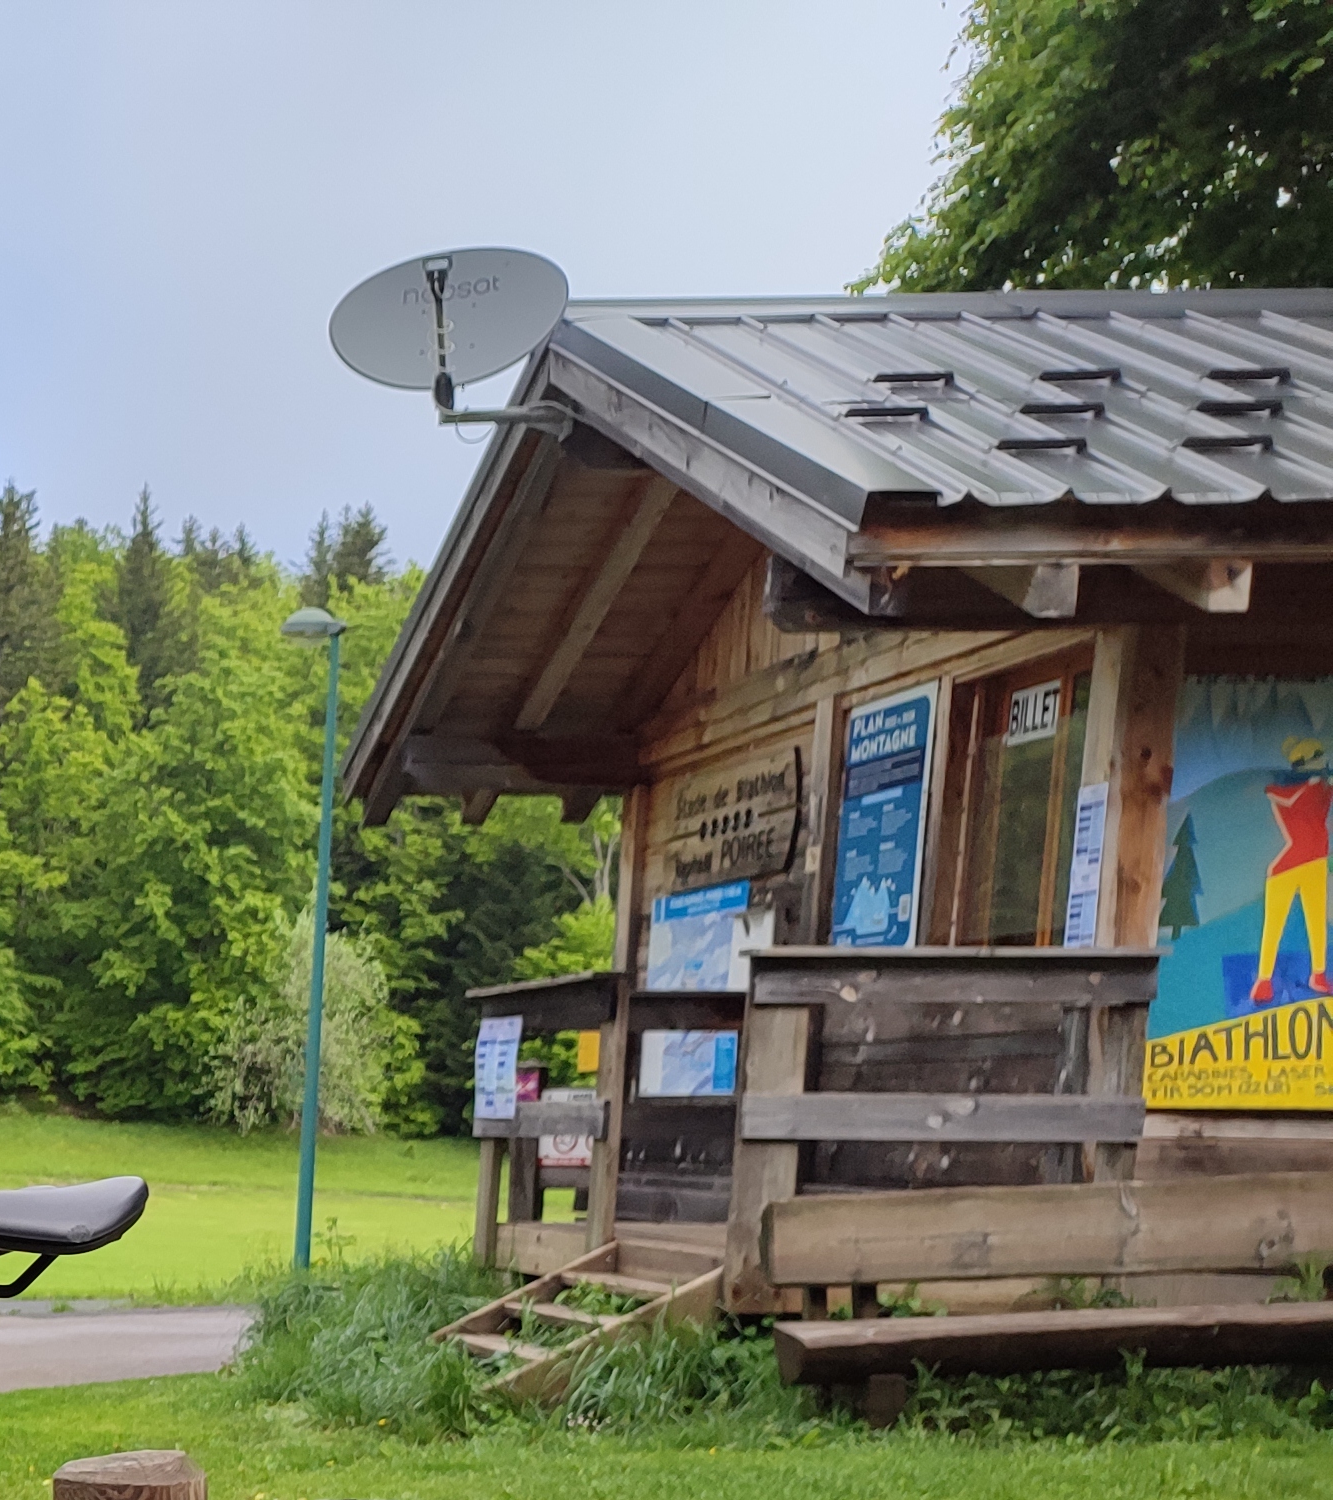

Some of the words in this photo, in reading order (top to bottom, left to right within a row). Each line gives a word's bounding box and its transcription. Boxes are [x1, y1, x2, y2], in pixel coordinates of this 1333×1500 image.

[852, 711, 884, 740] PLAN
[1010, 687, 1061, 737] BILLET
[851, 724, 917, 764] MONTAGNE
[1150, 1001, 1333, 1068] BIATHLON
